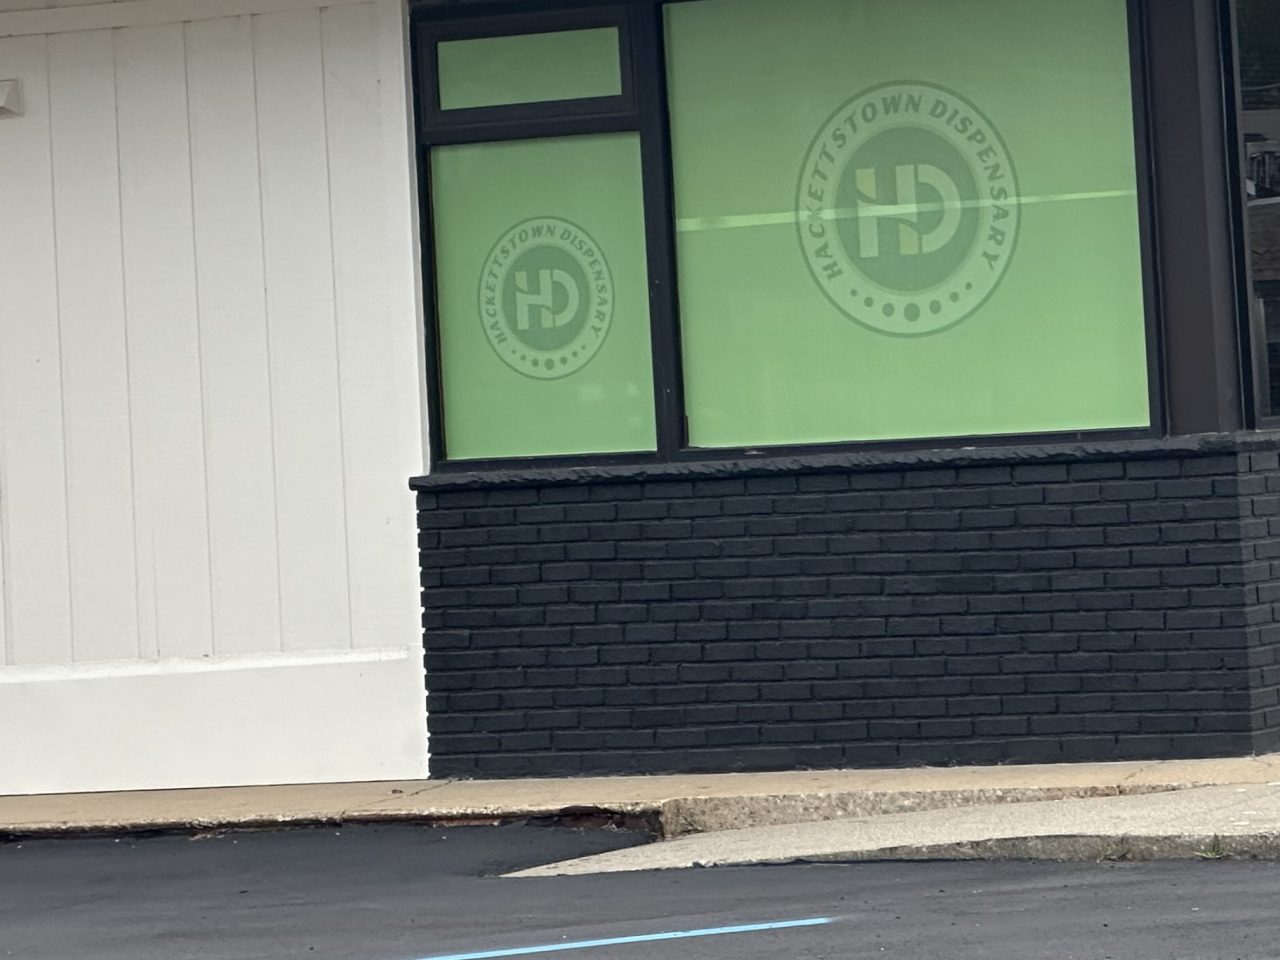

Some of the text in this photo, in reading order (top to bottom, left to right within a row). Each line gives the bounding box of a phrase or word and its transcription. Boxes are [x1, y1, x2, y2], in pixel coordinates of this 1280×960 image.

[806, 93, 1009, 281] HACKETTSTOWN DISPENSARY
[856, 164, 961, 258] HD
[485, 224, 608, 345] HACKETTSTOWN DISPENSARY
[515, 269, 579, 330] HD
